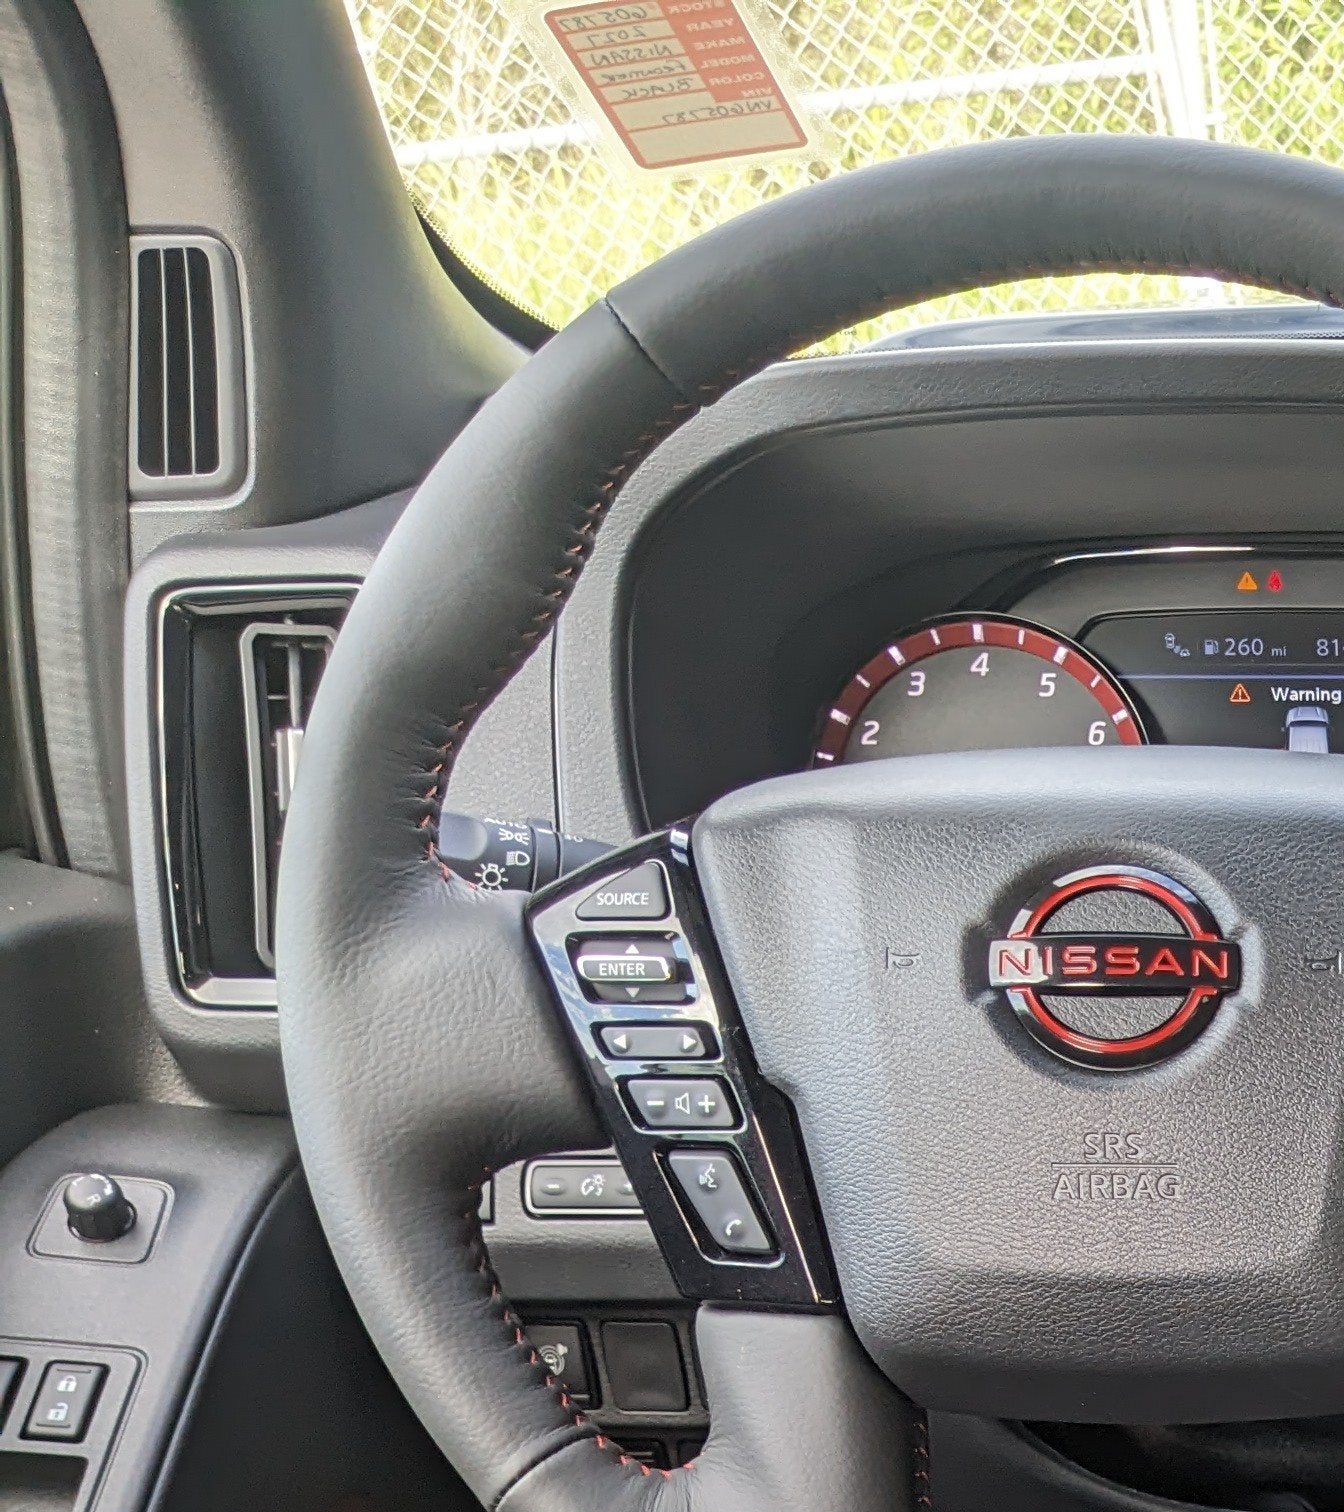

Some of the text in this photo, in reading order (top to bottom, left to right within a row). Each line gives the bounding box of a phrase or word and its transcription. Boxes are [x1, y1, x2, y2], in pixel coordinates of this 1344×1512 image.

[1224, 638, 1287, 657] 260 mi
[970, 652, 990, 676] 4
[907, 671, 926, 697] 3
[1038, 672, 1057, 697] 5
[1271, 686, 1342, 705] Warning
[860, 721, 880, 746] 2
[1087, 721, 1106, 746] 6
[596, 892, 650, 906] SOURCE
[599, 962, 646, 977] ENTER
[998, 946, 1229, 981] NISSAN
[1083, 1132, 1144, 1159] SRS
[1053, 1173, 1182, 1200] AIRBAG
